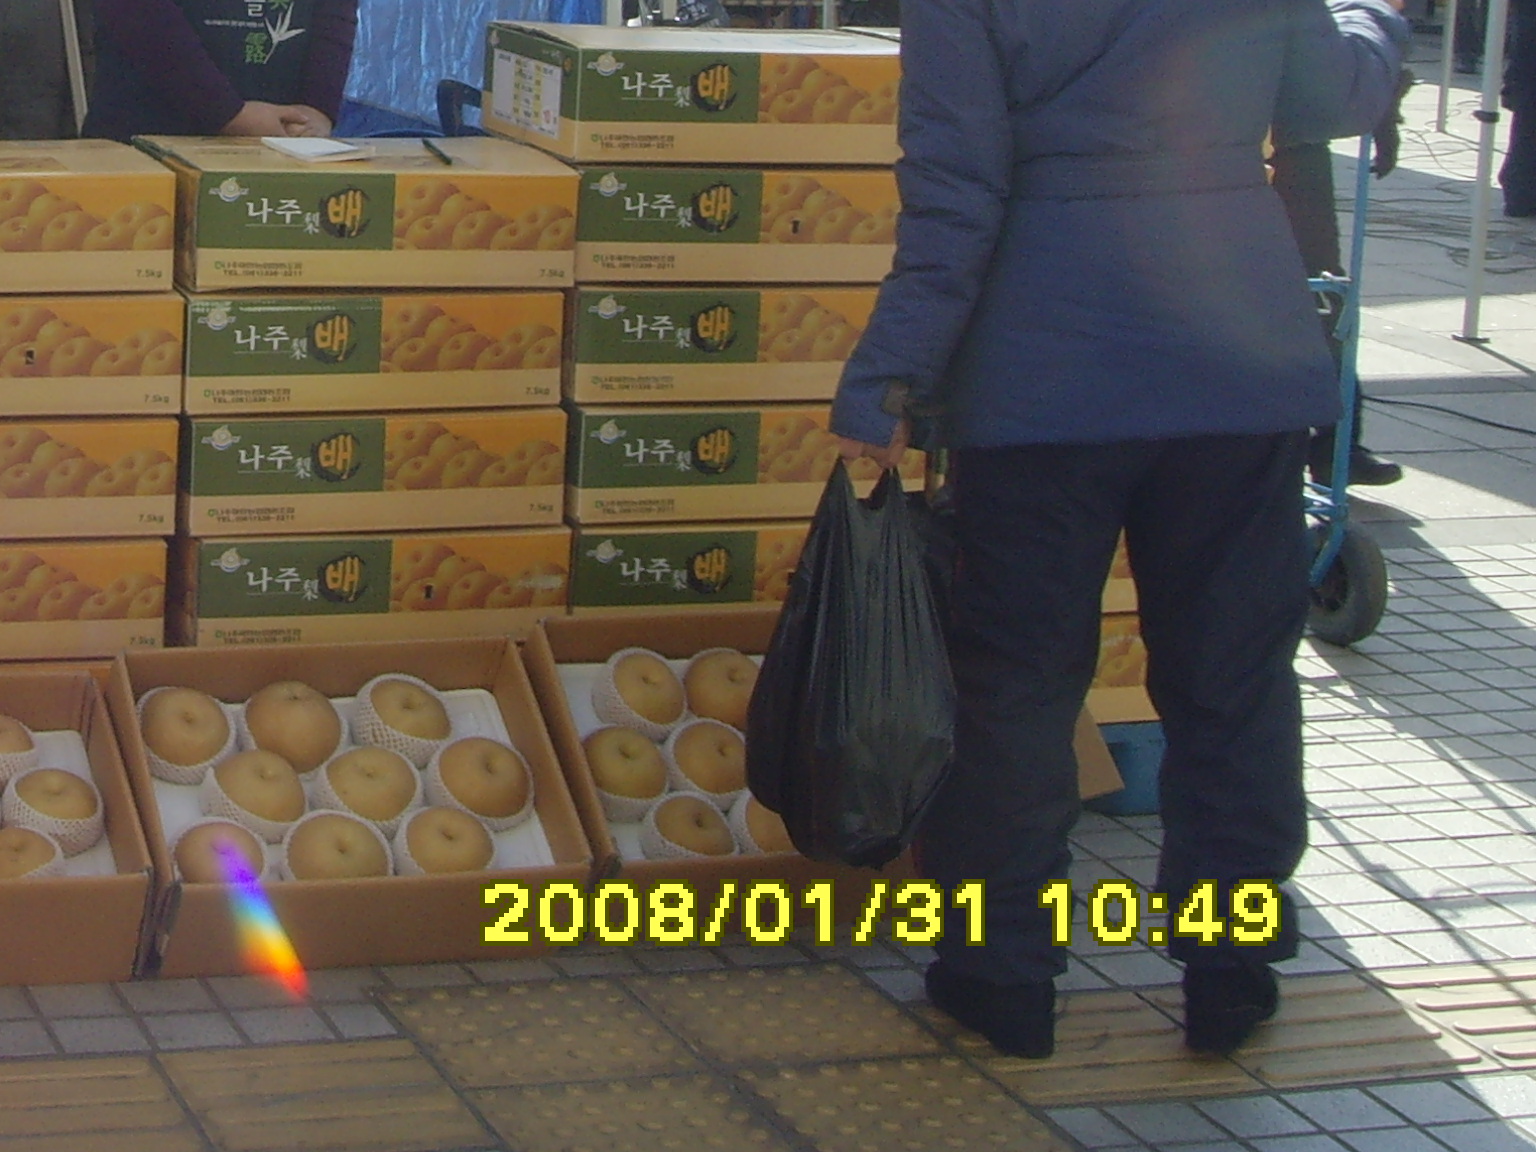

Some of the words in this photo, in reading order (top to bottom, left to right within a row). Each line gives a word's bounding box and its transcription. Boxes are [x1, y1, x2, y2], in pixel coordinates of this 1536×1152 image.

[621, 71, 674, 97] 나주
[697, 63, 729, 106] 배
[245, 197, 302, 224] 나주
[327, 188, 361, 234] 배
[623, 192, 676, 218] 나주
[699, 184, 731, 227] 배
[233, 324, 289, 351] 나주
[313, 316, 347, 361] 배
[621, 314, 674, 340] 나주
[697, 306, 729, 349] 배
[238, 444, 294, 470] 나주
[318, 436, 352, 481] 배
[623, 438, 674, 462] 나주
[696, 430, 727, 472] 배
[246, 566, 301, 591] 나주
[325, 558, 358, 602] 배
[619, 557, 671, 581] 나주
[693, 549, 725, 591] 배
